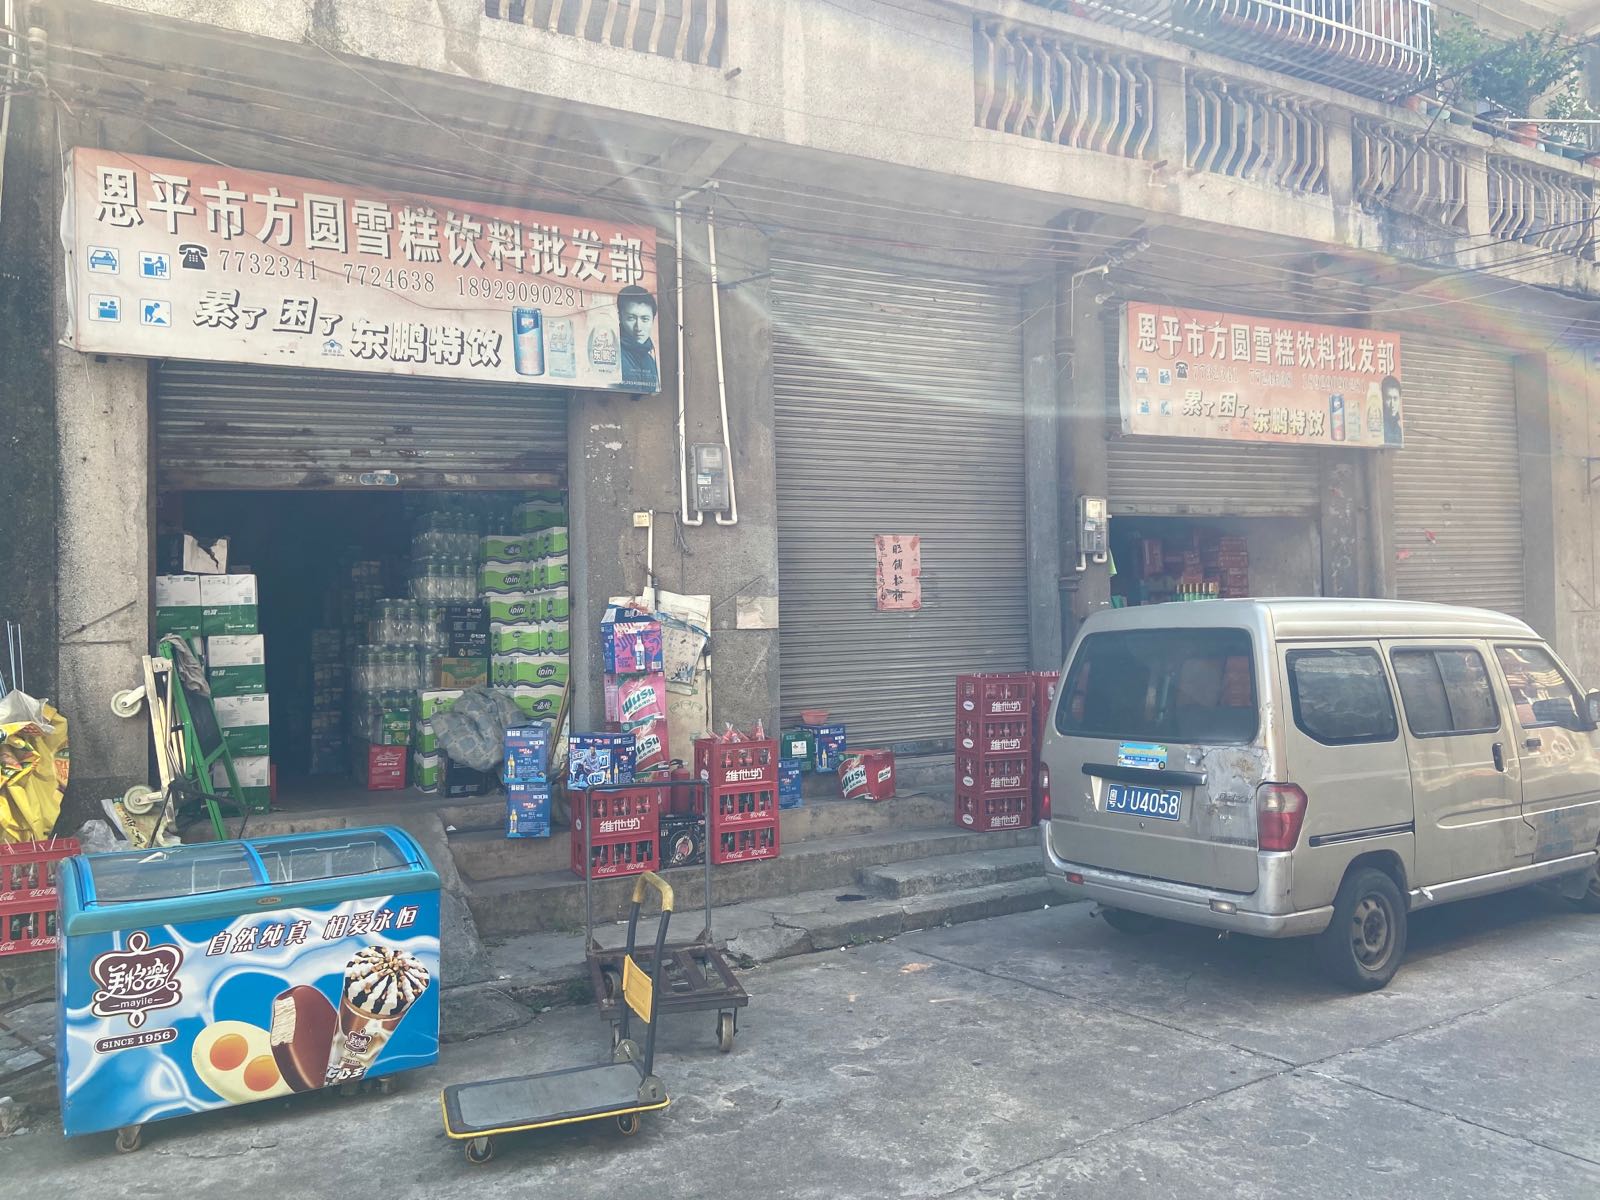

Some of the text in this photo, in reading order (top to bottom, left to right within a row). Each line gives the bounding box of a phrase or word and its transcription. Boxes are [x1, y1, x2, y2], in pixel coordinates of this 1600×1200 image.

[95, 165, 644, 286] 恩平市方圆雪糕饮料批发部
[219, 250, 585, 308] 7732341 7724638 18929090281
[1137, 312, 1396, 376] 恩平市方圆雪糕饮料批发部
[725, 768, 763, 783] 維他奶
[600, 817, 641, 833] 維他奶
[205, 905, 420, 956] 自然纯真 相爱永恒
[120, 997, 153, 1010] mayile
[101, 1031, 171, 1050] SINCE 1956
